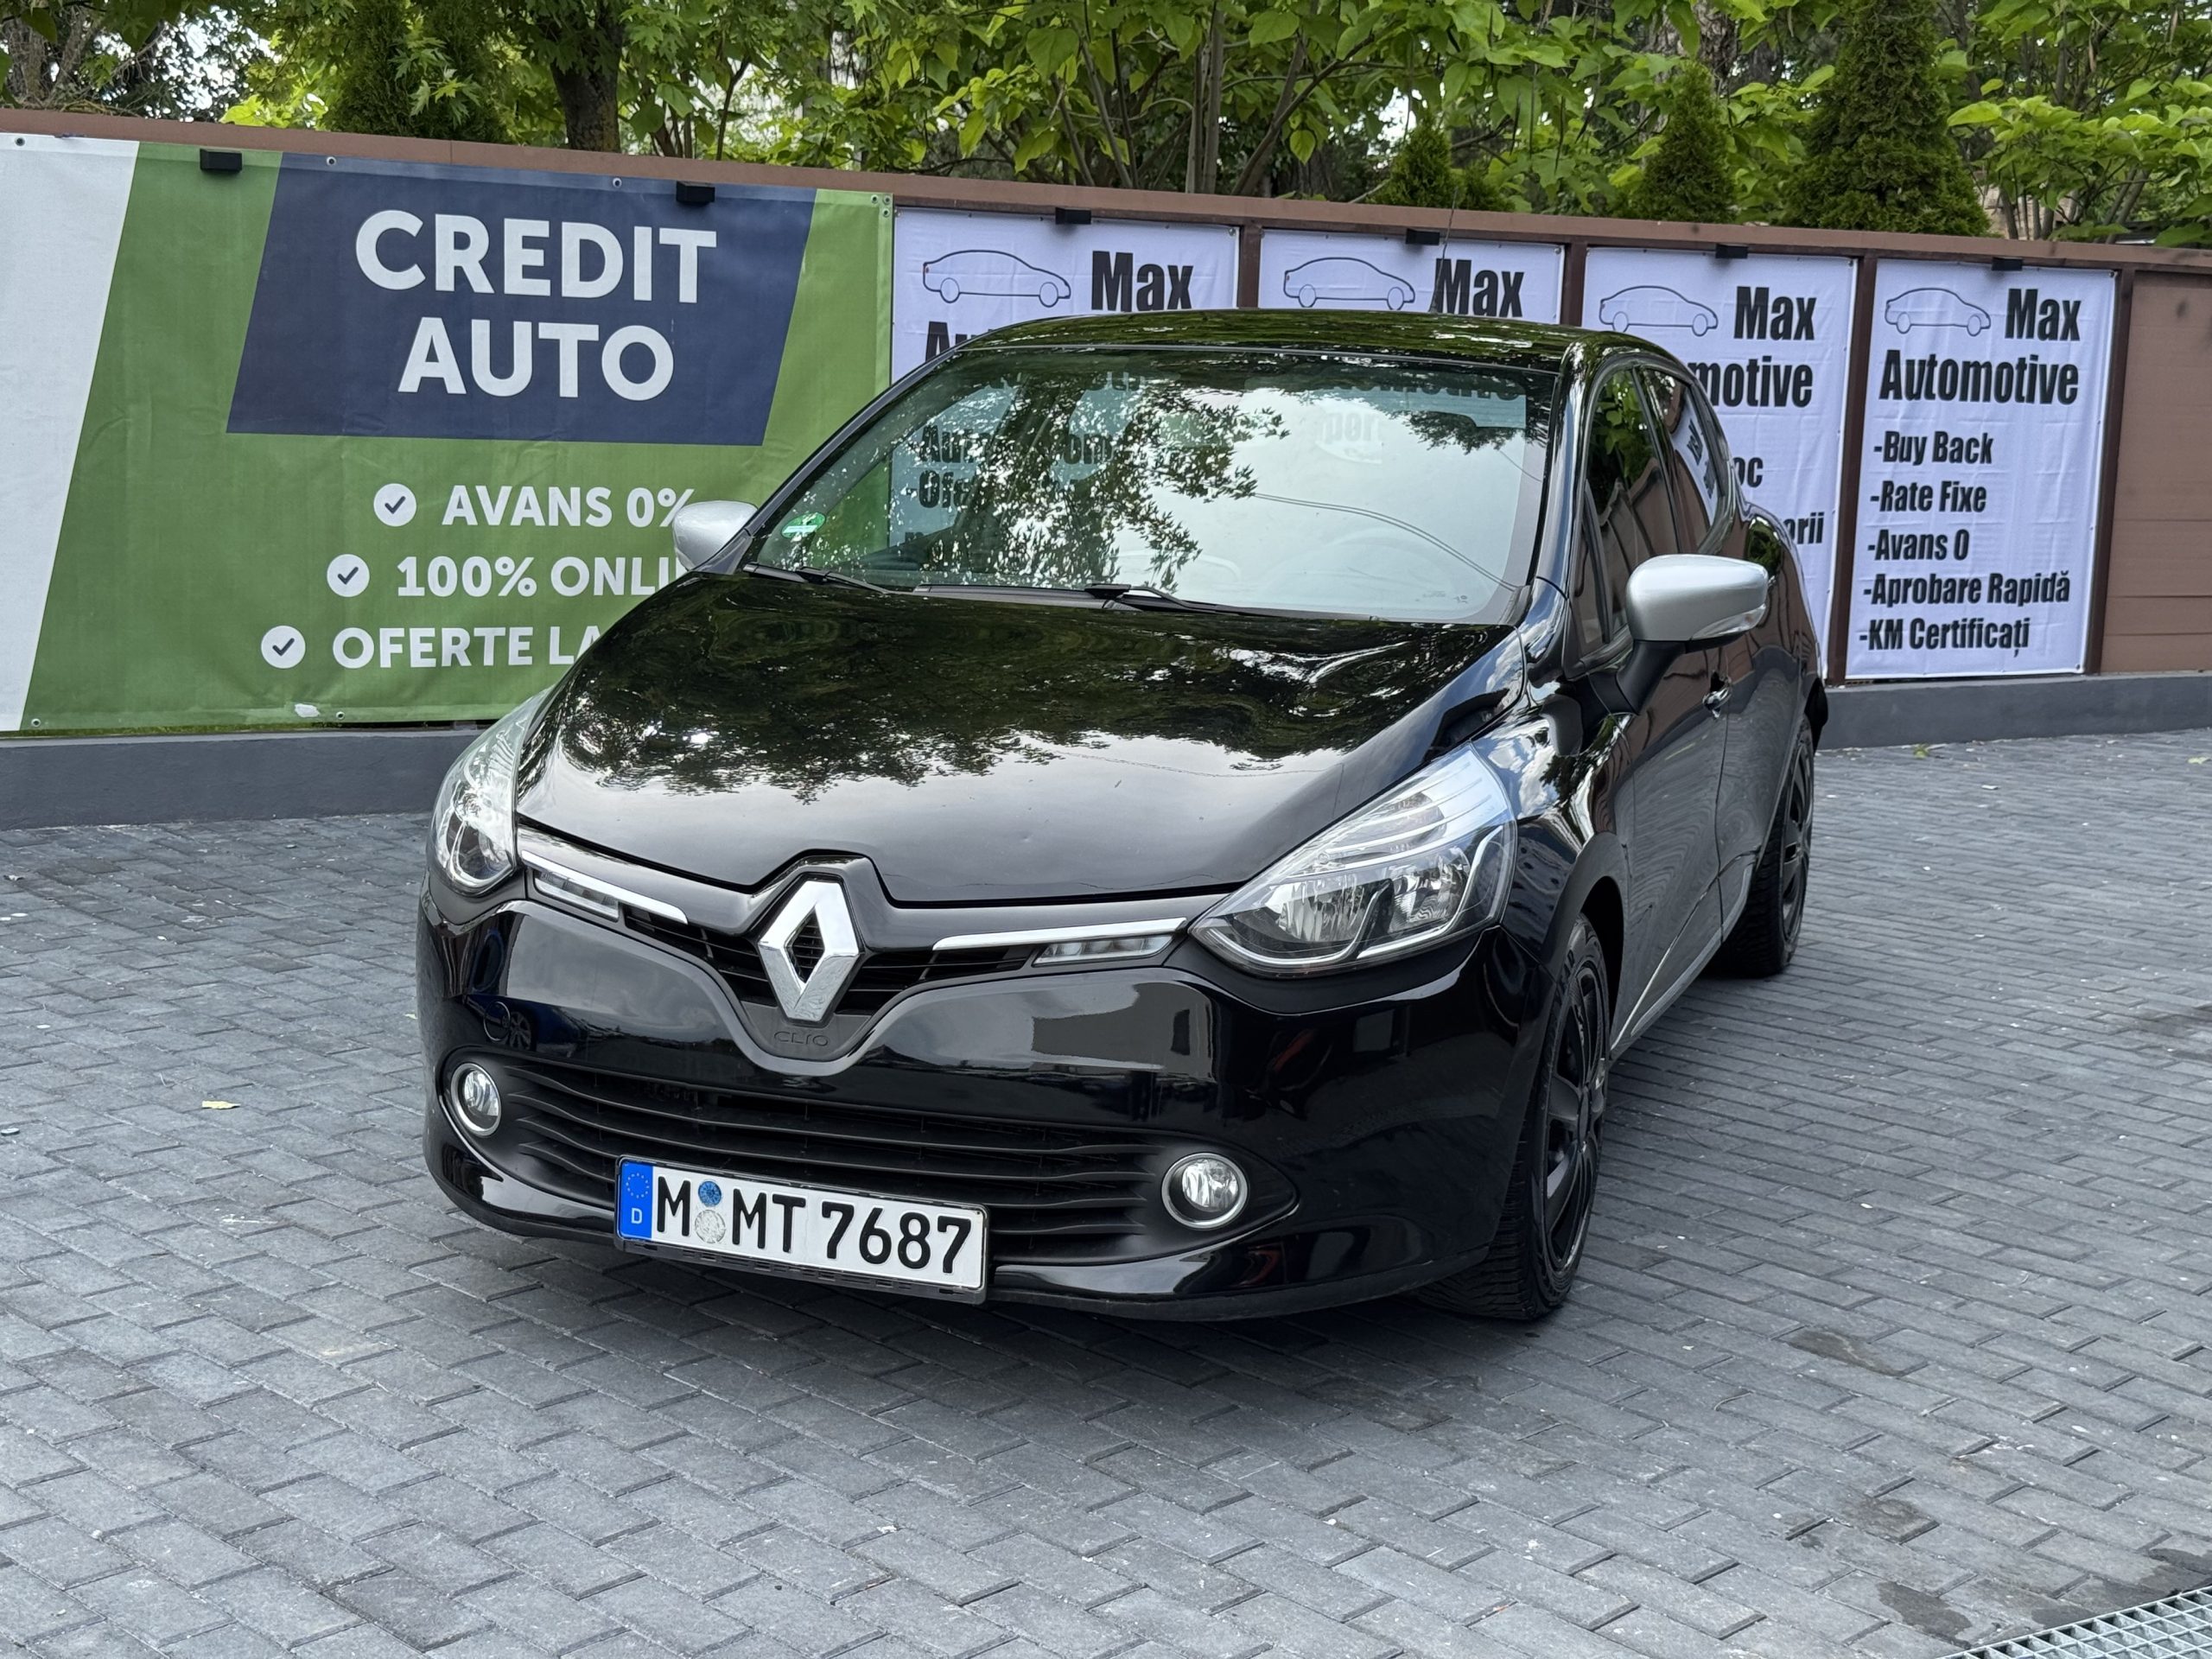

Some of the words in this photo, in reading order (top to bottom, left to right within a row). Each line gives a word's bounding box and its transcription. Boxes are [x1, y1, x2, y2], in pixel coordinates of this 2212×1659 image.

[355, 209, 717, 303] CREDIT
[1091, 250, 1194, 313] Max
[1434, 257, 1524, 318] Max
[1733, 285, 1817, 340] Max
[2005, 288, 2082, 341] Max
[397, 316, 674, 401] AUTO
[1878, 349, 2079, 404] Automotive
[1688, 355, 1813, 408] motive
[1873, 430, 1928, 467] -Buy
[1932, 430, 1994, 464] Back
[442, 485, 613, 527] AVANS
[626, 486, 695, 528] 0%
[1870, 480, 1934, 512] -Rate
[1939, 480, 1987, 512] Fixe
[1867, 529, 1948, 561] -Avans
[397, 556, 537, 597] 100%
[1863, 573, 1982, 607] -Aprobare
[1986, 570, 2070, 607] Rapidă
[332, 626, 533, 669] OFERTE
[1859, 618, 1904, 651] -KM
[1909, 617, 2031, 658] Certificați
[773, 1031, 829, 1047] CLIO
[631, 1207, 643, 1225] D
[657, 1176, 691, 1237] M
[732, 1188, 806, 1254] MT
[822, 1201, 972, 1274] 7687
